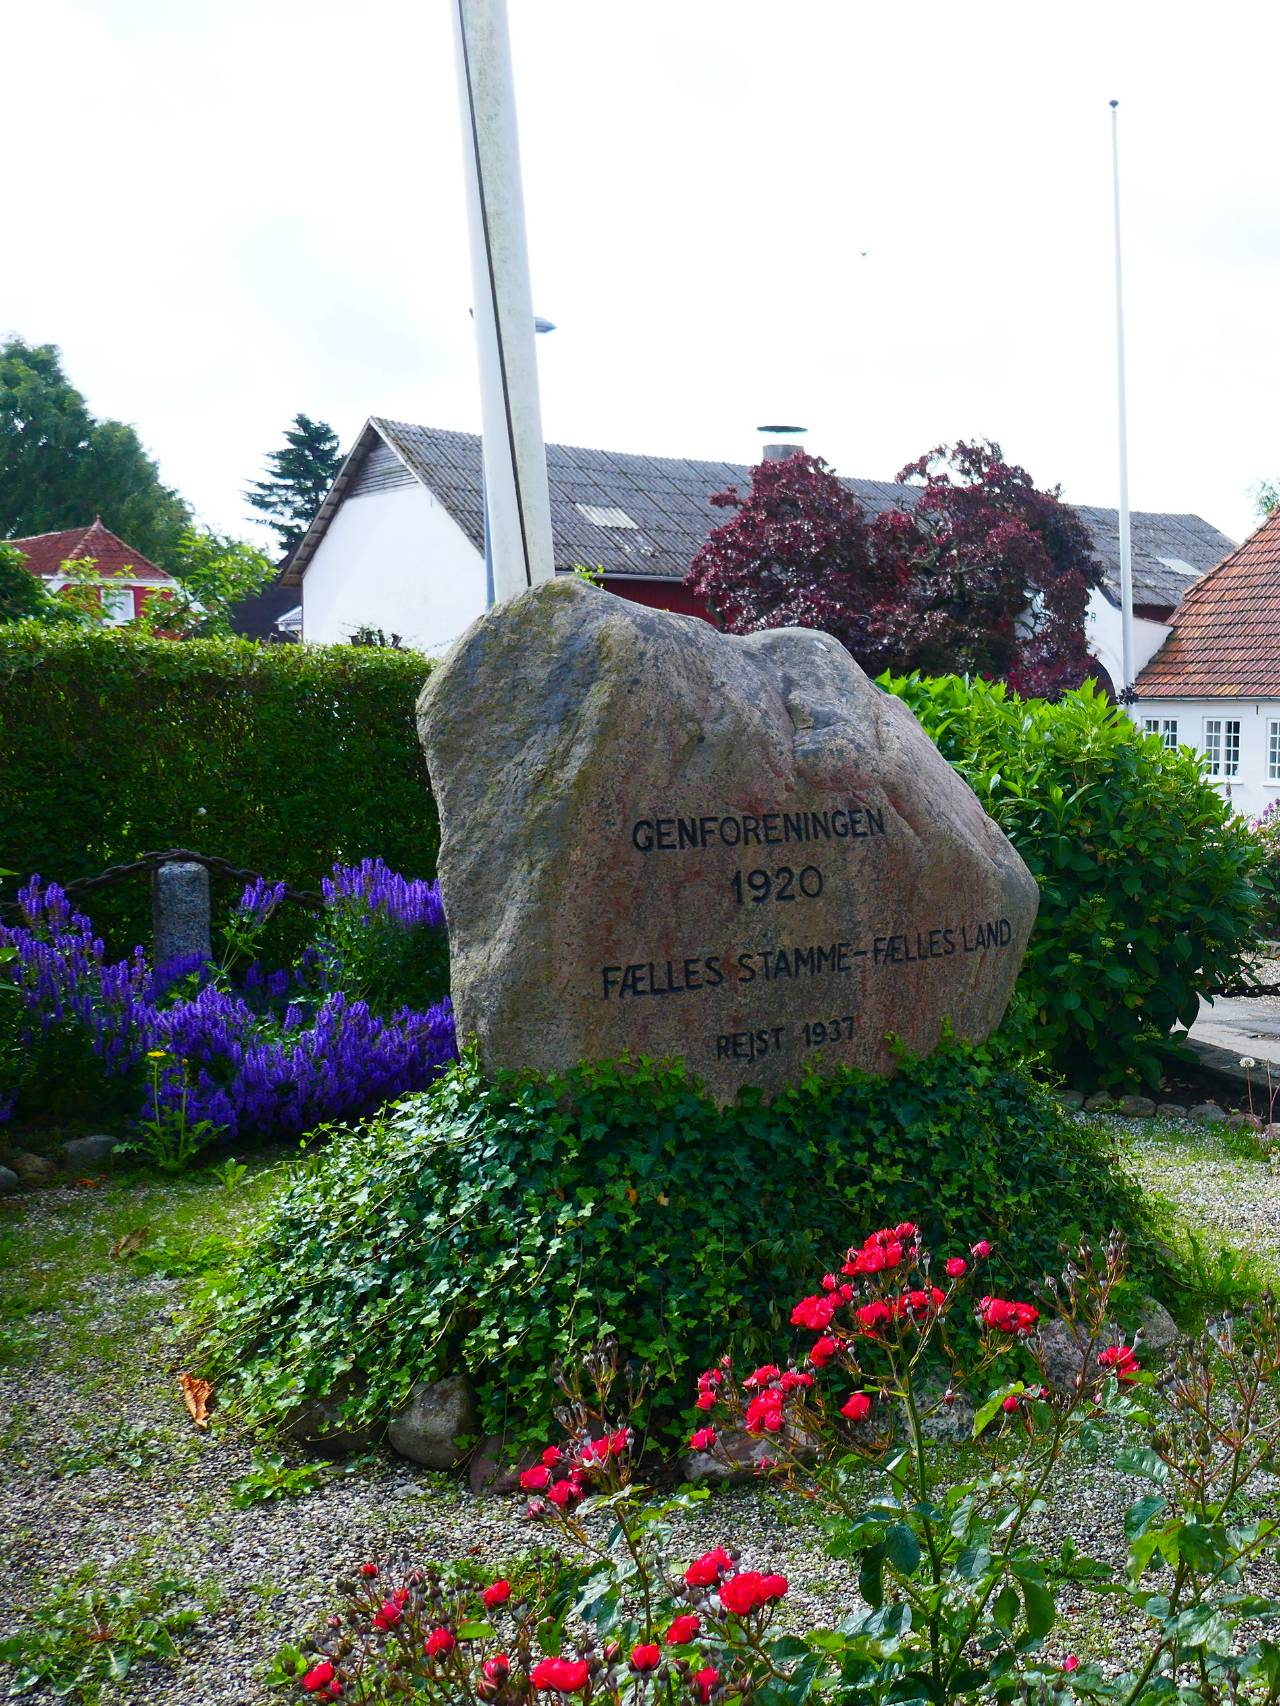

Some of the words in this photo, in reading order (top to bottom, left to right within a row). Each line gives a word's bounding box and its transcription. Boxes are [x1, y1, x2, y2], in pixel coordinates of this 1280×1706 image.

[632, 808, 886, 852] GENFORENINGEN
[731, 865, 824, 904] 1920
[602, 956, 725, 1000] FÆLLES
[961, 918, 1012, 952] LAND
[716, 1027, 785, 1064] REJST
[801, 1016, 854, 1047] 1937
